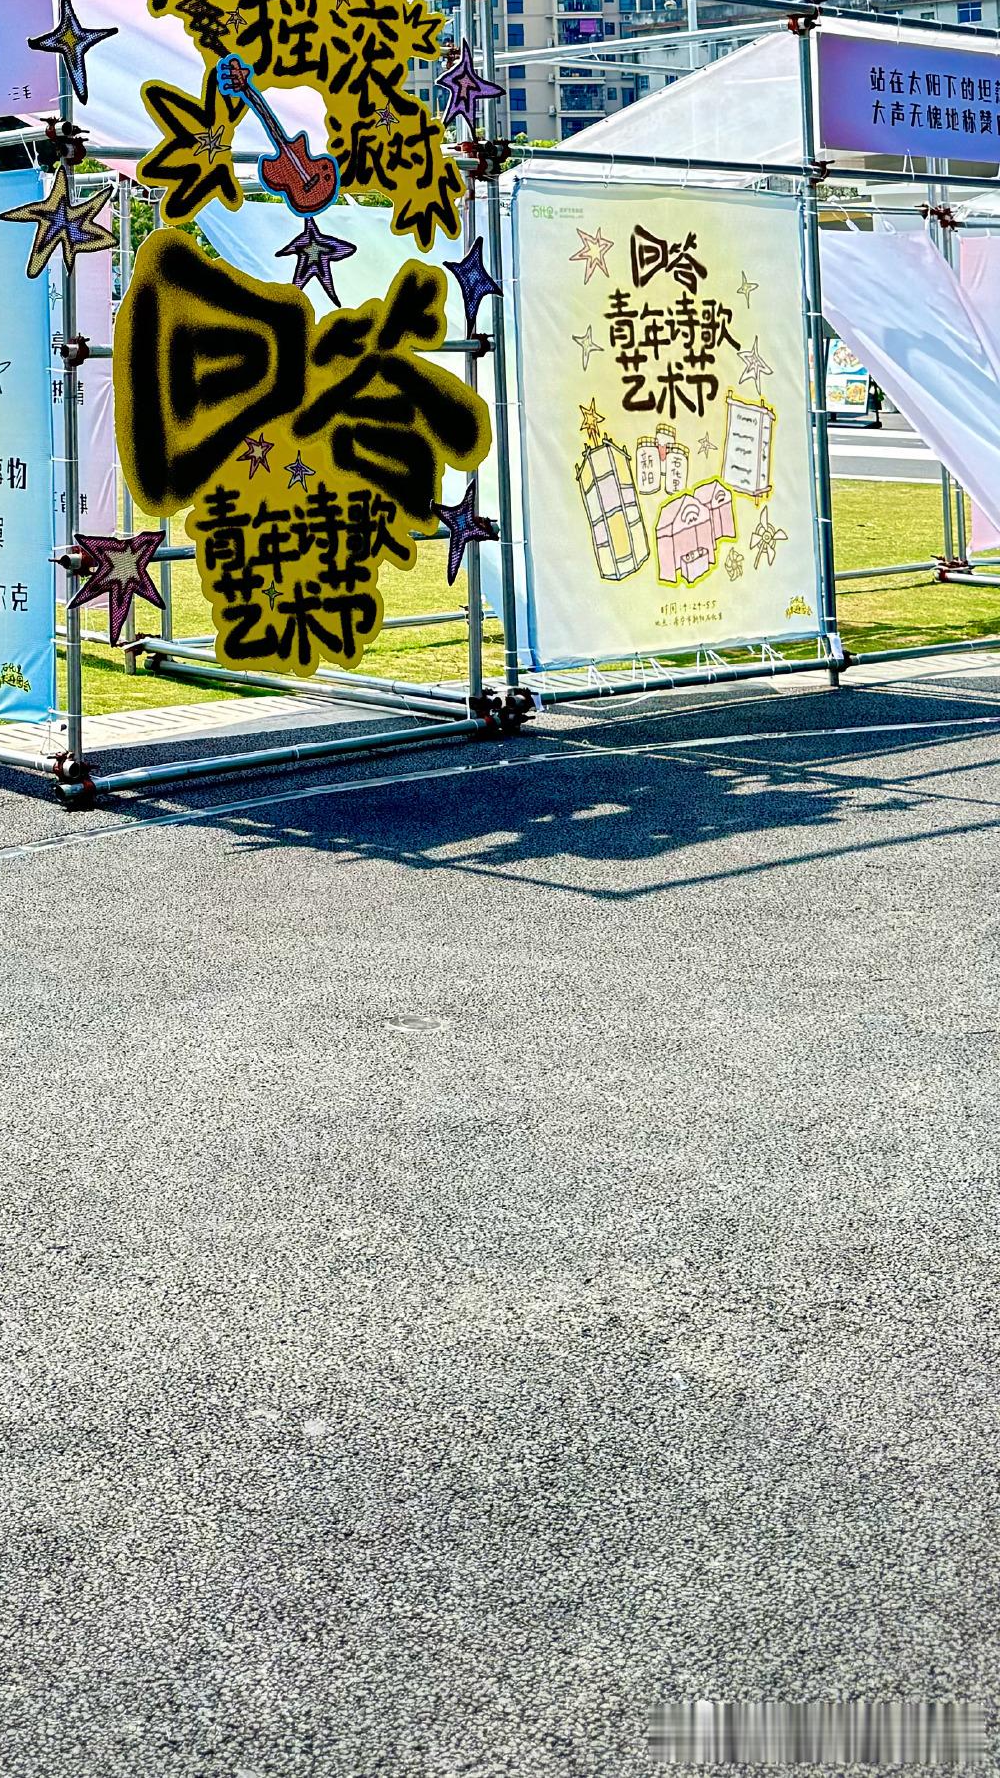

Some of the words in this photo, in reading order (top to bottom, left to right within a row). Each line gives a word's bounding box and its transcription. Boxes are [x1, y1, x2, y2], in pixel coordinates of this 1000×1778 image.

[331, 122, 440, 190] 派对
[630, 224, 708, 295] 回答
[604, 287, 742, 360] 青年诗歌
[130, 242, 479, 522] 回答
[615, 348, 719, 419] 艺术节
[196, 483, 410, 571] 青年诗歌
[213, 563, 377, 665] 艺术节
